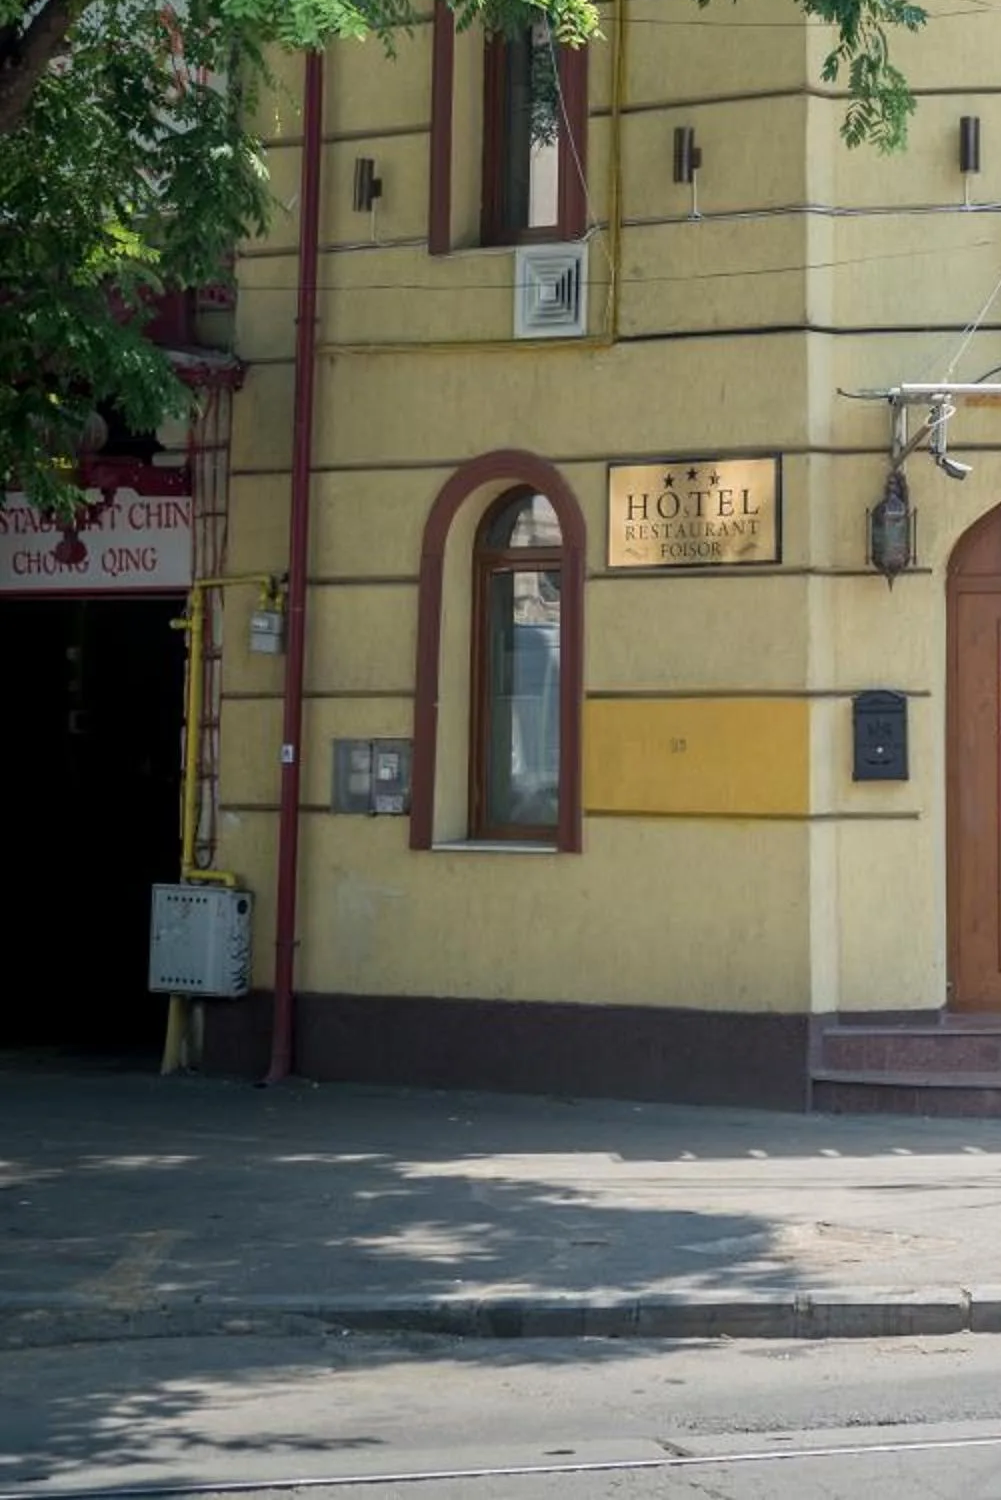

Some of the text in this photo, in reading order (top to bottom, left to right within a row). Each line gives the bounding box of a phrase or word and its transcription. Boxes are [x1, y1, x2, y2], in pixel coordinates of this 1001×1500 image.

[128, 501, 191, 530] CHIN
[625, 520, 761, 541] RESTAURANT
[102, 547, 158, 577] QING
[660, 541, 723, 558] FOISOR
